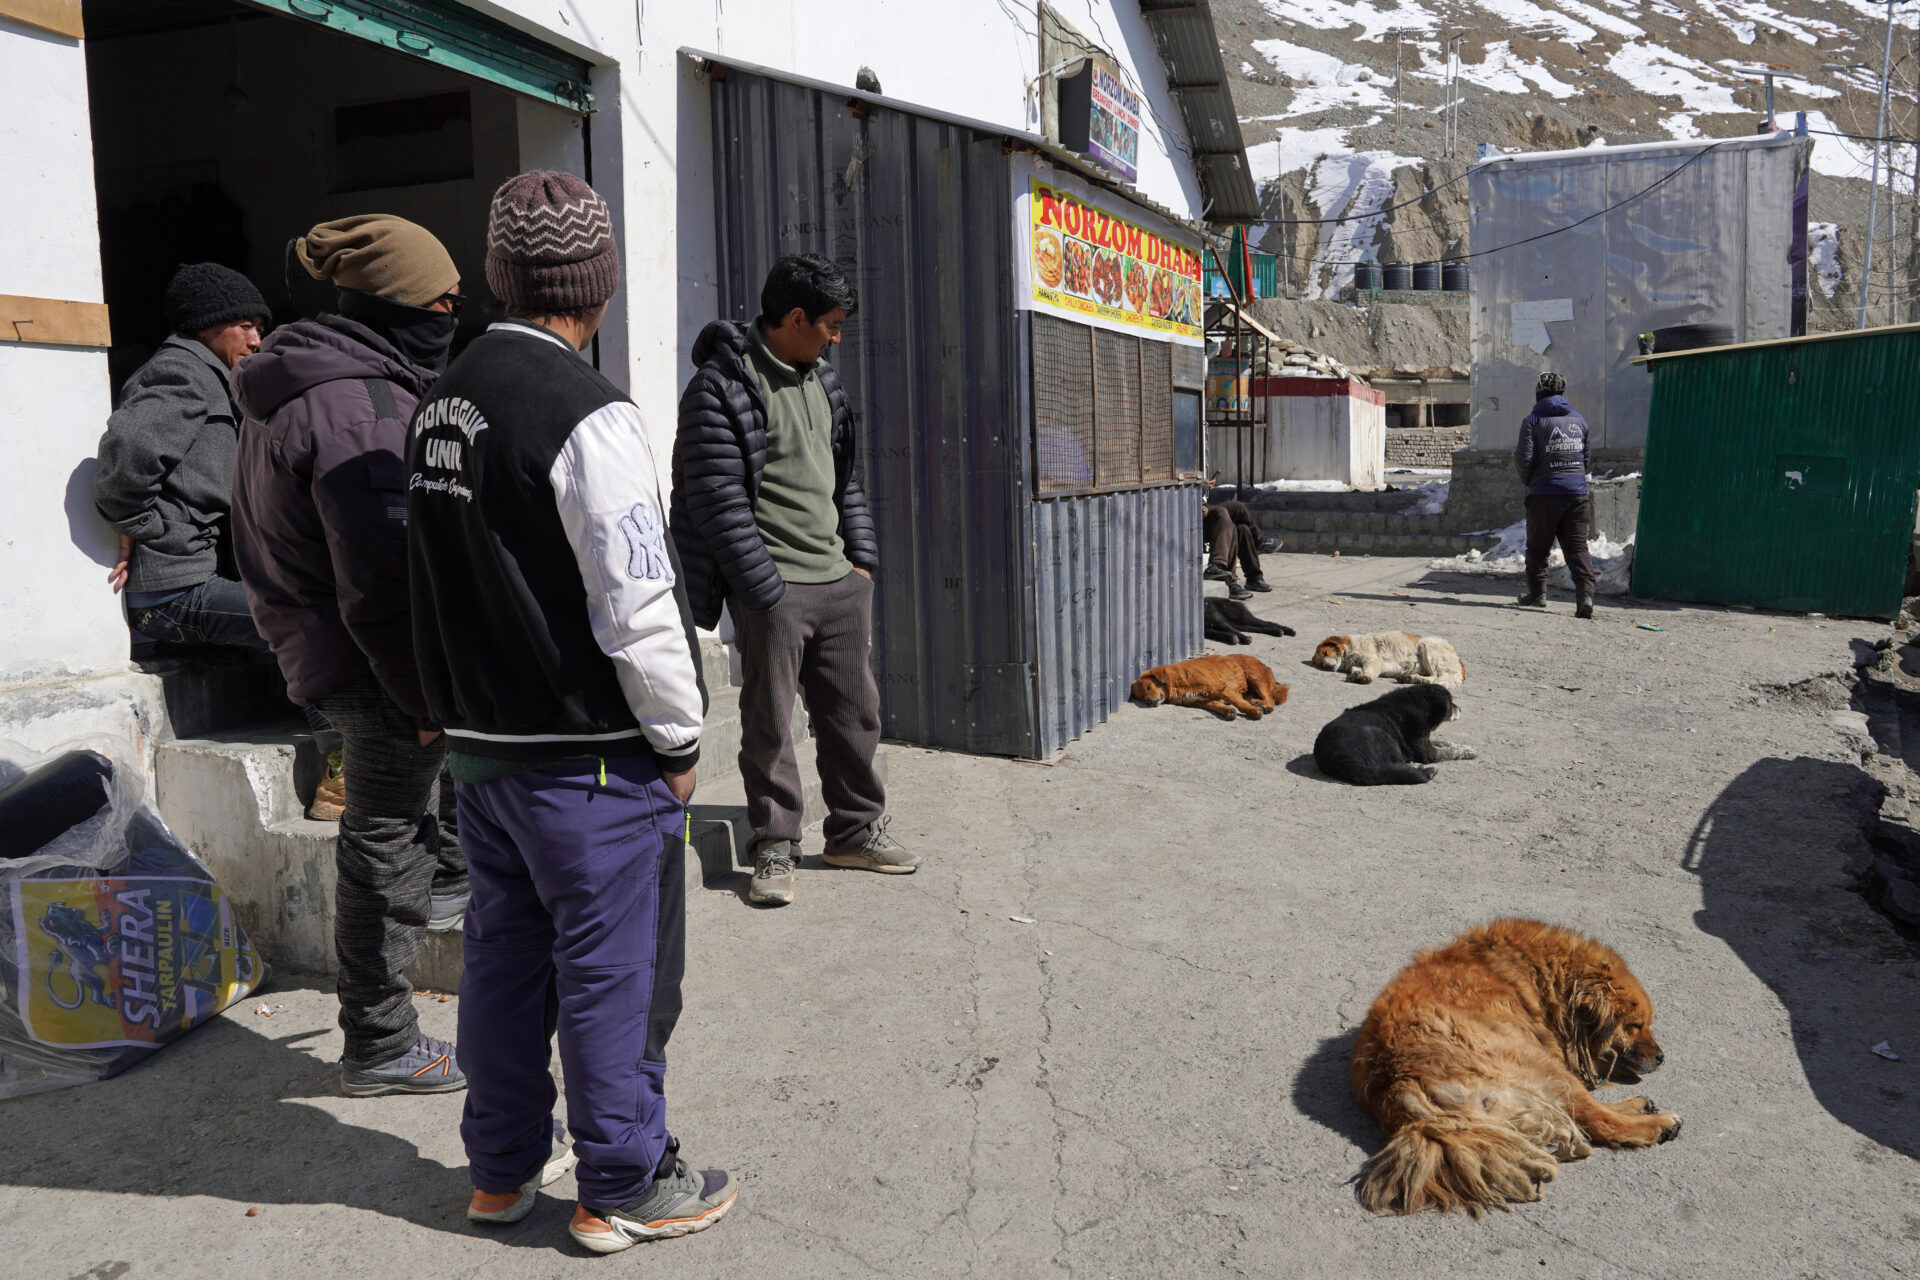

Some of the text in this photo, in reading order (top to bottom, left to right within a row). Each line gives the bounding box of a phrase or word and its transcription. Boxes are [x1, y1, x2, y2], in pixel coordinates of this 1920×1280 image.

[1099, 68, 1140, 117] NORZOM DHABA
[1039, 187, 1202, 283] NORZOM DHABA
[415, 397, 488, 446] DONGGUK
[410, 472, 448, 494] Computer
[116, 888, 161, 1029] SHERA
[156, 899, 178, 1010] TARPAULIN
[223, 926, 231, 948] SIZE
